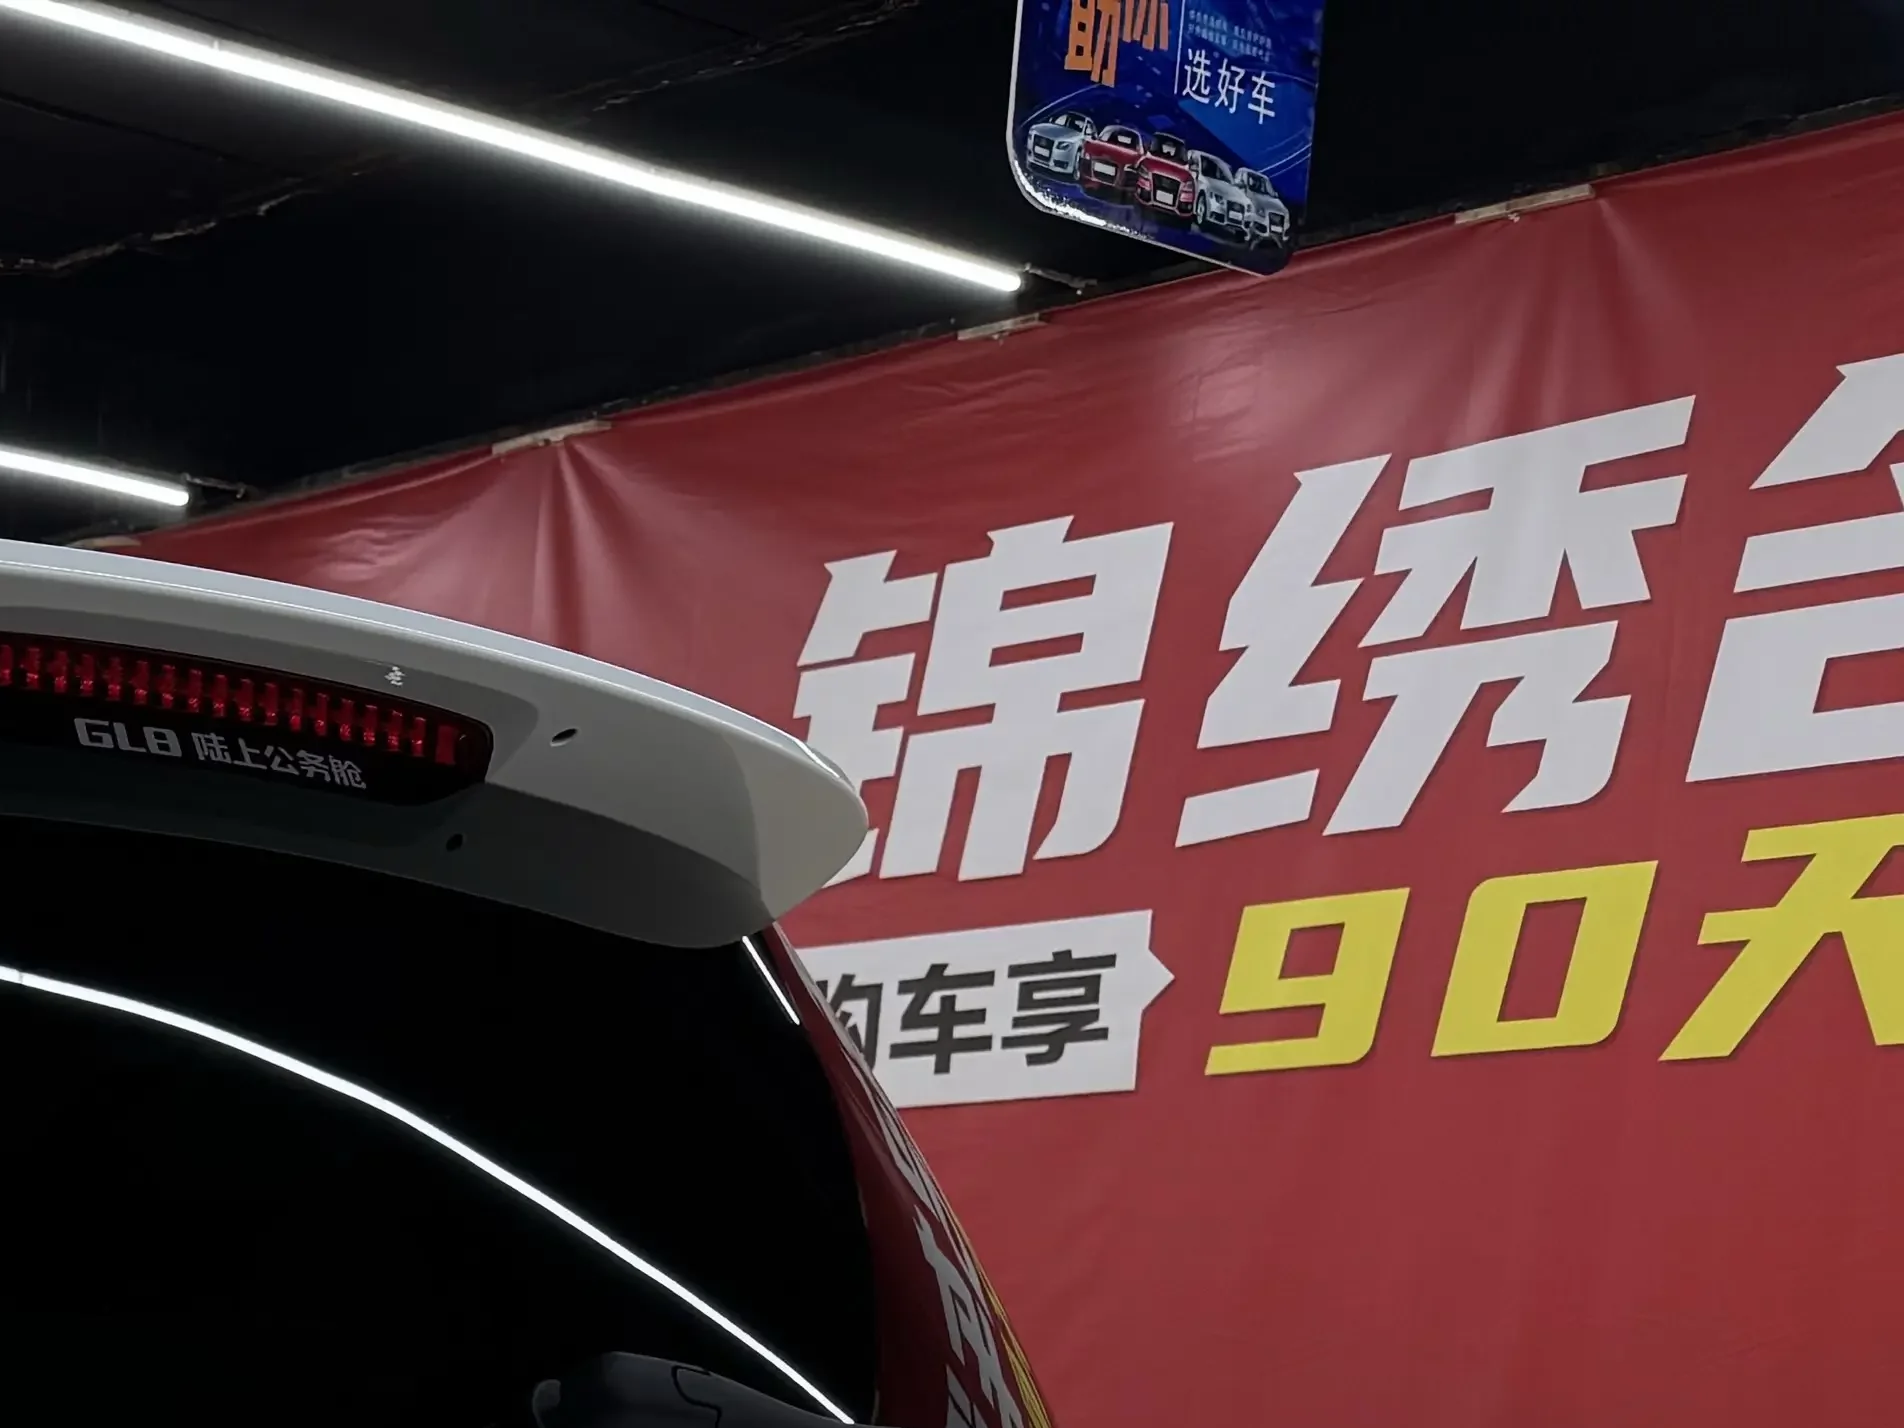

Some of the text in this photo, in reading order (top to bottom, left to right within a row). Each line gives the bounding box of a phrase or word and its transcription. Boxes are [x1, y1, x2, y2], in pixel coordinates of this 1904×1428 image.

[1182, 48, 1276, 125] 选好车
[73, 717, 367, 791] GL8 陆上公务舱
